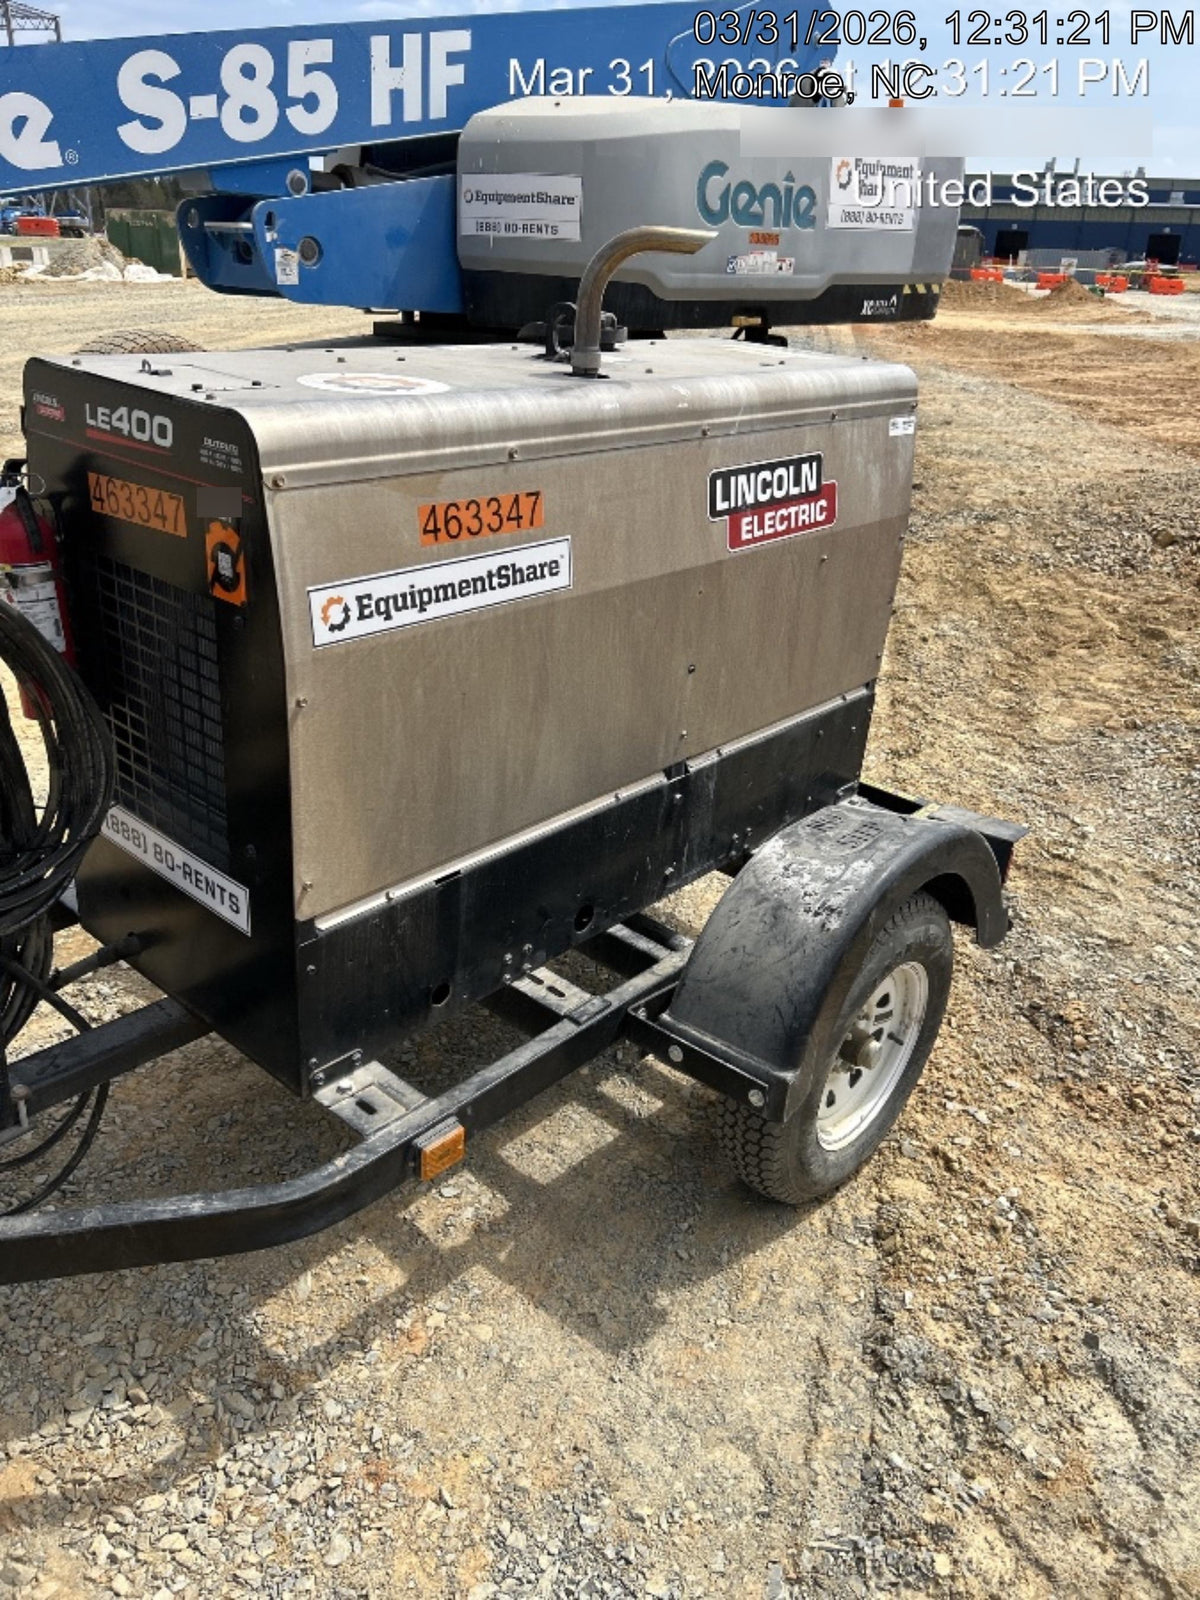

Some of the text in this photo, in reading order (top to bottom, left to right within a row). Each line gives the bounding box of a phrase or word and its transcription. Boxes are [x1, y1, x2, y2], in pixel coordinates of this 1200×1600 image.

[117, 29, 472, 155] S-85 HF
[474, 189, 577, 206] EquipmentShare
[697, 159, 817, 230] Genie
[84, 402, 174, 448] LE400
[91, 474, 183, 533] 463347
[715, 461, 818, 512] LINCOLN
[421, 490, 542, 542] 463347
[741, 499, 828, 541] ELECTRIC
[353, 556, 561, 622] EquipmentShare
[152, 841, 241, 916] 80-RENTS
